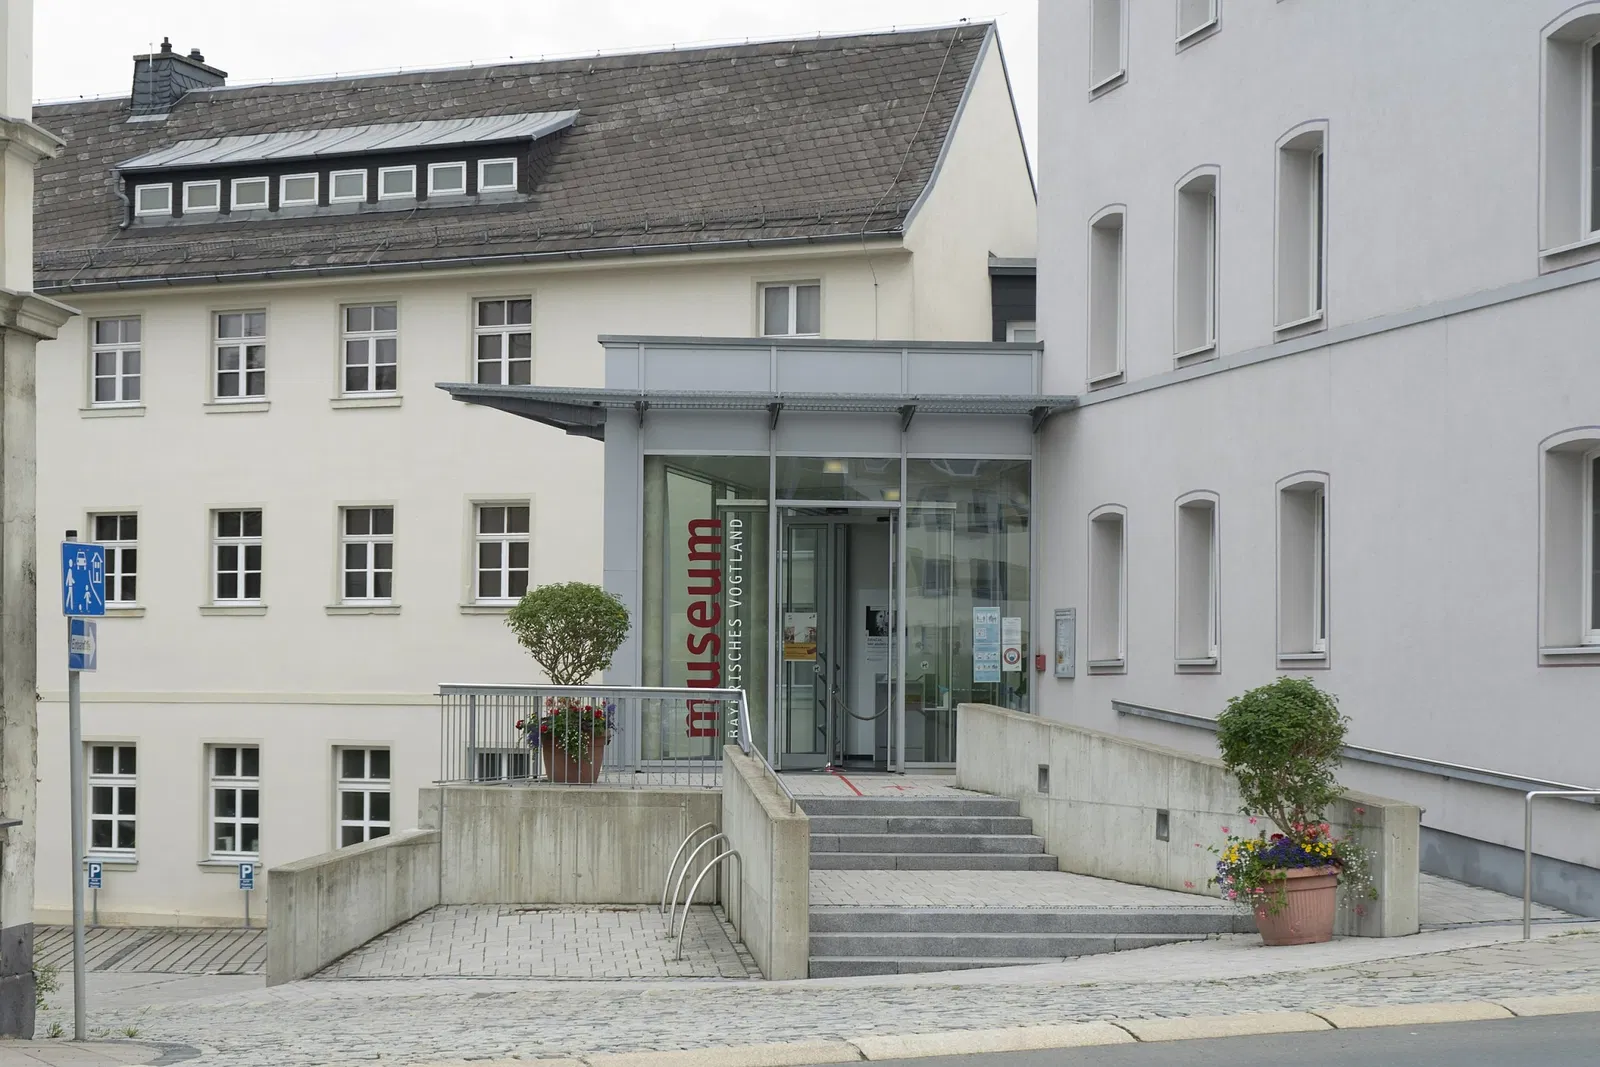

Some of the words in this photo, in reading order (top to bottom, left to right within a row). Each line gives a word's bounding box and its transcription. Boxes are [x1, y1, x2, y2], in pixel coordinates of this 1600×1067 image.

[729, 519, 743, 608] VOGTLAND
[686, 519, 721, 737] museum
[90, 864, 100, 878] P
[242, 864, 251, 879] P
